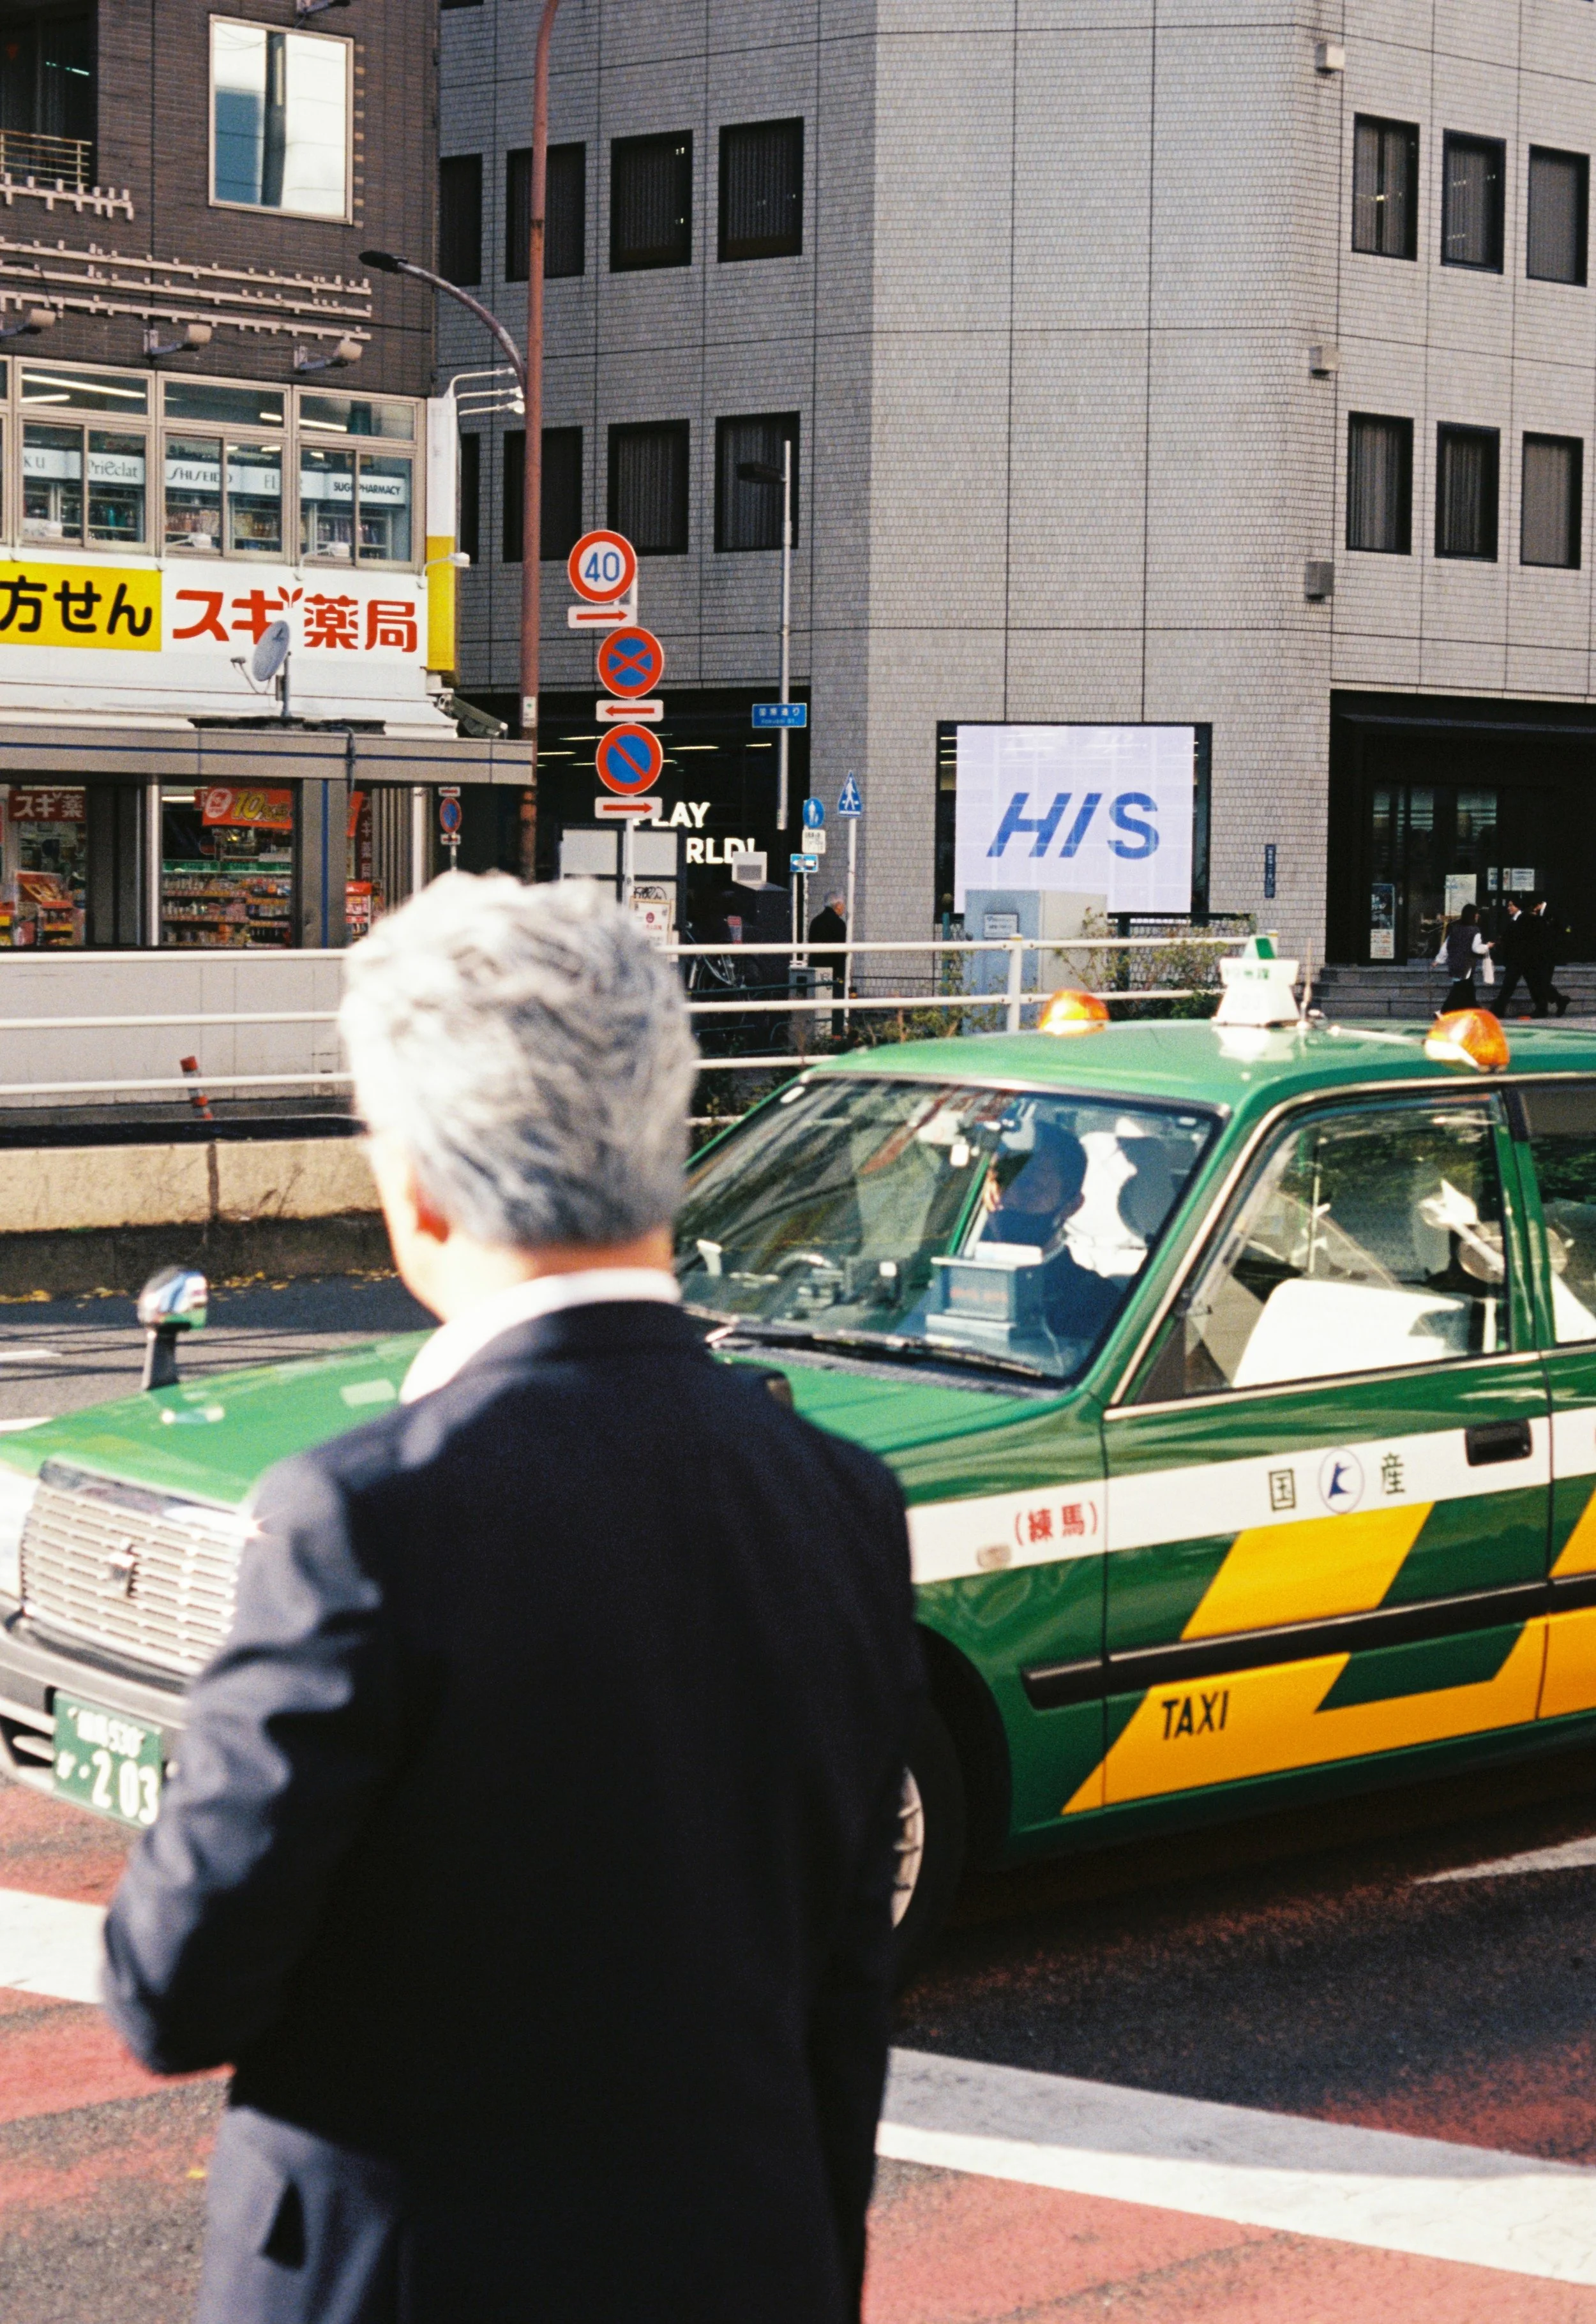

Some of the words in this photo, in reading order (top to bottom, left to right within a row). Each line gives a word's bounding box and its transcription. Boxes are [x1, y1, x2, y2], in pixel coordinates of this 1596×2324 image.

[333, 481, 353, 492] SUG
[359, 484, 402, 495] PHARMACY
[585, 551, 619, 581] 40
[0, 574, 152, 636] 方せん
[172, 586, 418, 652] スギ薬局
[986, 792, 1159, 860] HIS
[1161, 1690, 1230, 1741] TAXI
